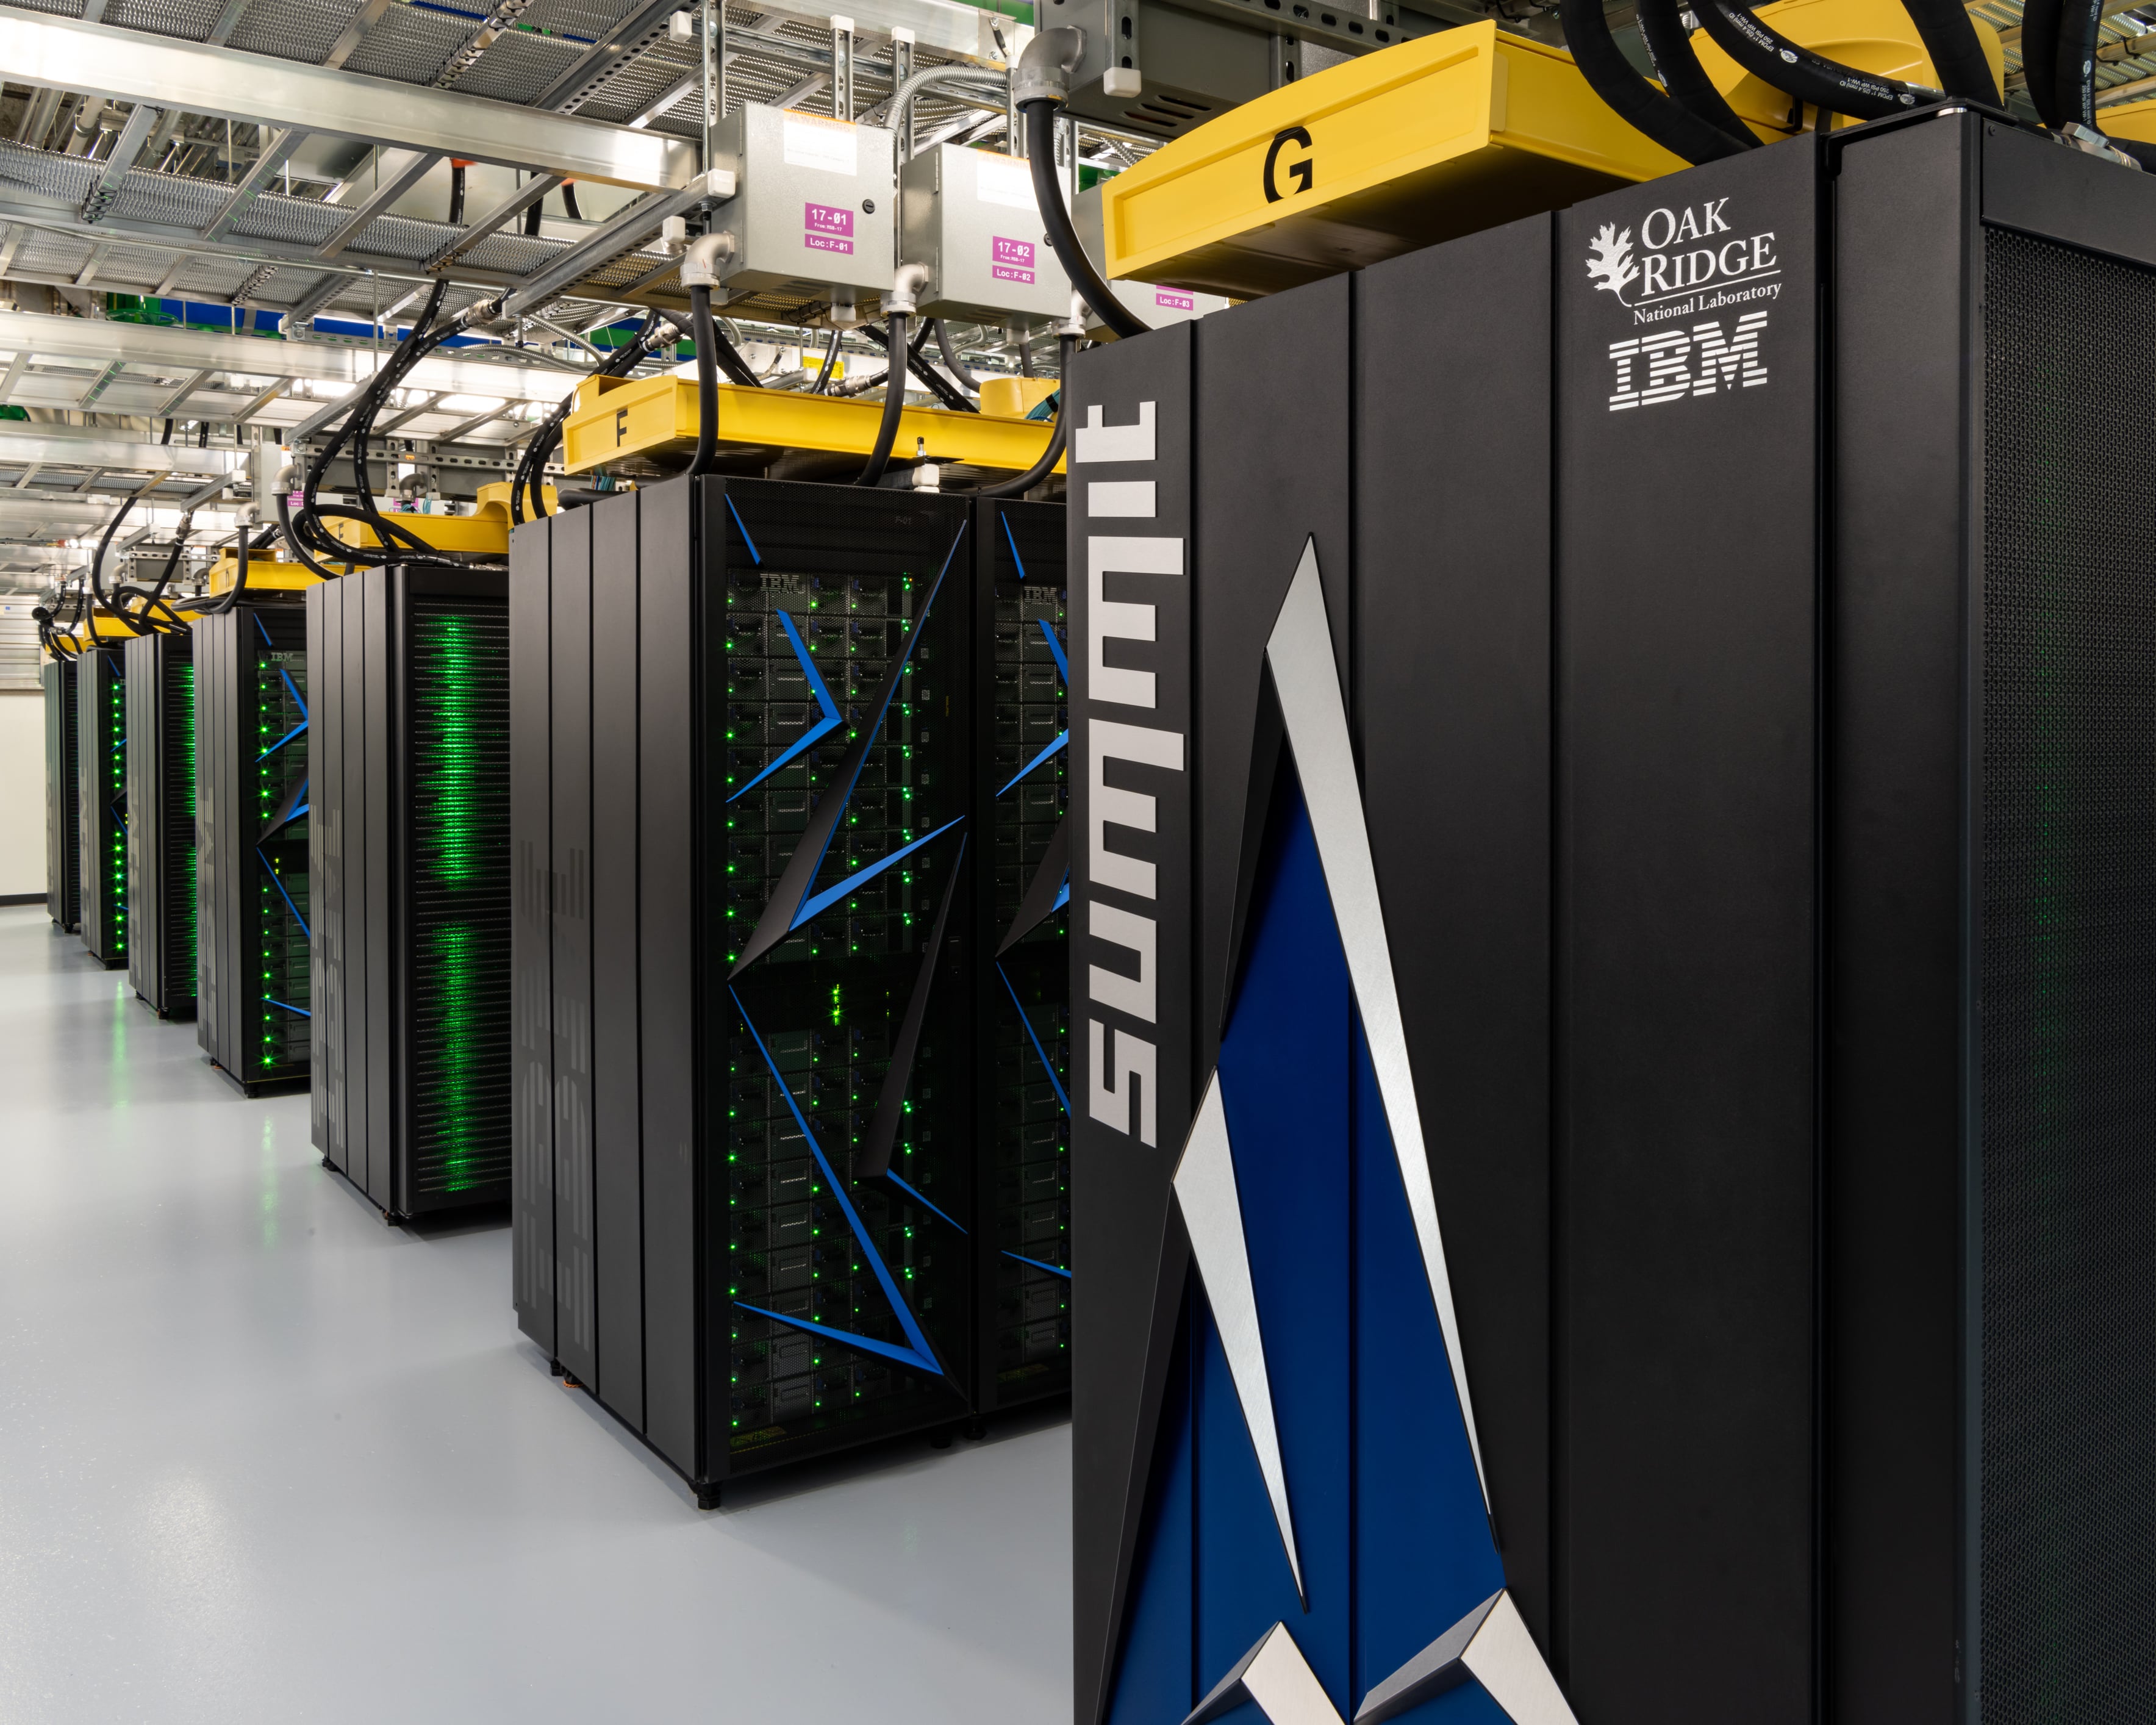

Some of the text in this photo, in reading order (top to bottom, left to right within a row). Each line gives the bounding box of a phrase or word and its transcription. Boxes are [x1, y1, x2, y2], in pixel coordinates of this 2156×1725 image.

[1737, 13, 1749, 25] VW-1
[1755, 29, 1764, 38] PSI
[1758, 39, 1774, 52] EPDM
[1877, 92, 1893, 101] EPDM
[1263, 126, 1313, 204] G
[812, 209, 846, 225] 17-01
[1642, 197, 1731, 249] OAK
[810, 237, 848, 251] Loc:F-01
[998, 242, 1030, 257] 17-02
[1641, 232, 1777, 296] RIDGE
[997, 268, 1031, 281] Loc:F-02
[1160, 296, 1190, 308] Loc:F-03
[1634, 283, 1782, 325] National Laboratory
[1609, 310, 1767, 412] IBM
[616, 407, 628, 447] F
[760, 573, 800, 593] IBM
[1024, 586, 1057, 604] IBM
[271, 652, 293, 662] IBM
